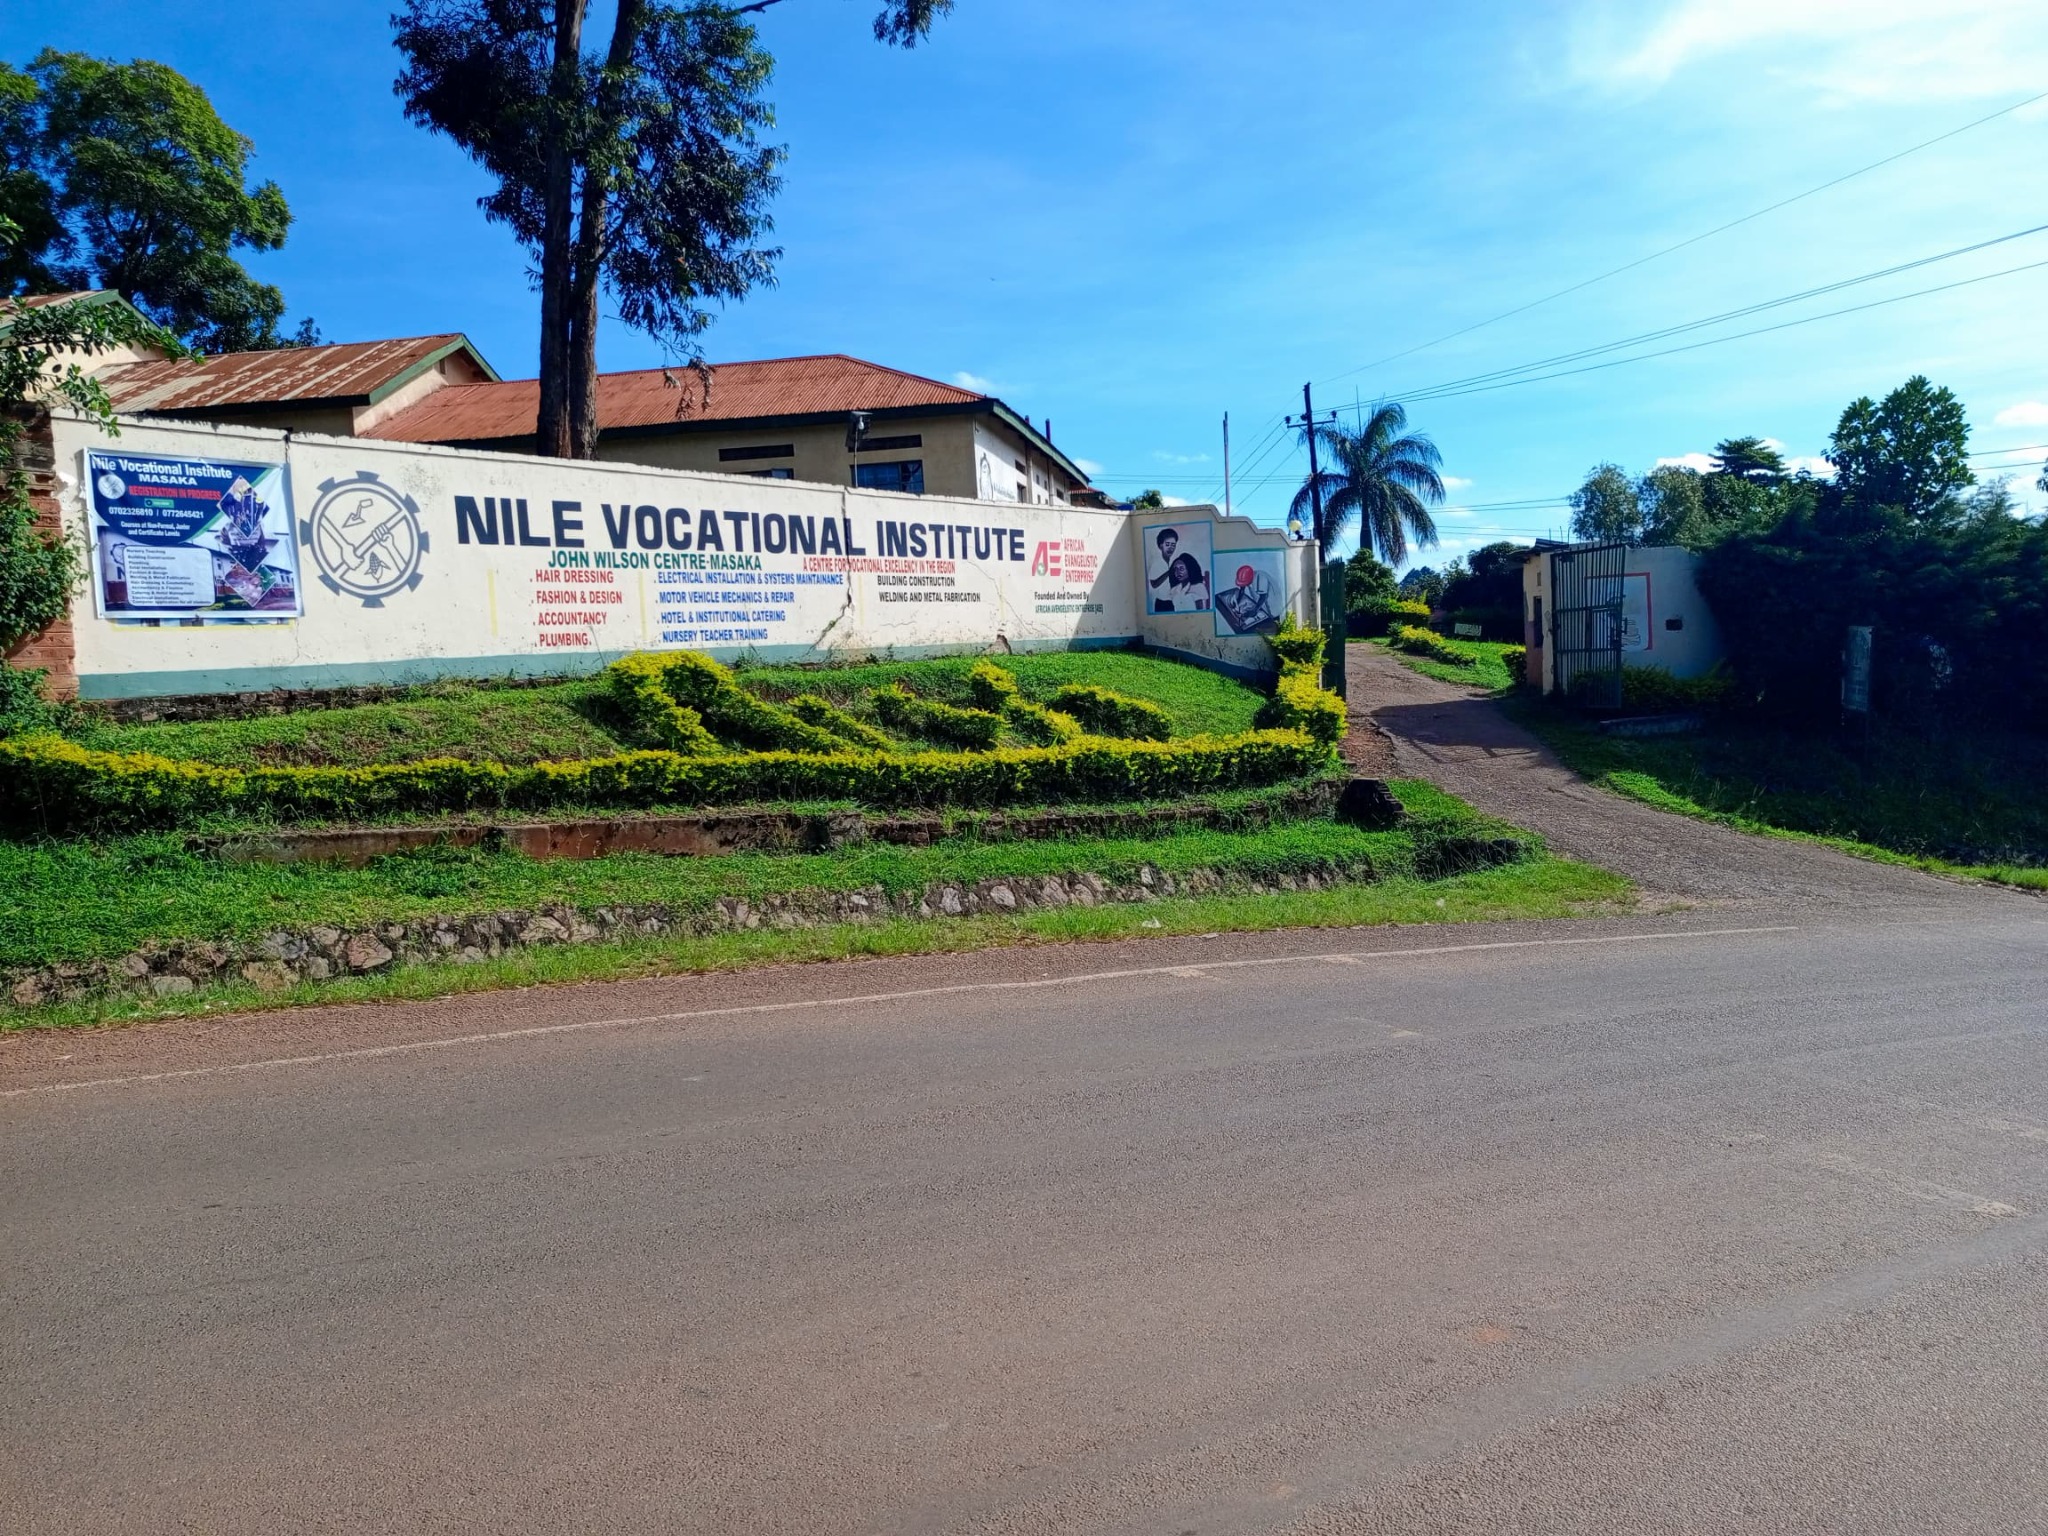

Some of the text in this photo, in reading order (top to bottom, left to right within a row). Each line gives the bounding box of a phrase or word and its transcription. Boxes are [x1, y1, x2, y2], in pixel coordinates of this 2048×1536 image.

[92, 456, 233, 479] Nile Vocational Institute
[138, 474, 198, 486] MASAKA
[129, 485, 221, 501] REGISTRATION IN PROGRESS
[454, 495, 1025, 562] NILE VOCATIONAL INSTITUTE
[1064, 538, 1085, 552] AFRICAN
[548, 550, 590, 569] JOHN
[594, 551, 649, 570] WILSON
[803, 558, 808, 572] A
[809, 558, 834, 573] CENTRE
[835, 558, 847, 573] FOR
[885, 559, 918, 573] EXCELLENCY
[919, 560, 926, 574] IN
[926, 560, 935, 574] THE
[936, 560, 956, 575] REGION
[1065, 554, 1098, 568] EVANGELISTIC
[536, 569, 614, 584] HAIR DRESSING
[658, 571, 844, 586] ELECTRICAL INSTALLATION & SYSTEMS MAINTAINANCE
[877, 575, 955, 587] BUILDING CONSTRUCTION
[1065, 570, 1094, 583] ENTERPRISE
[537, 590, 622, 604] FASHION & DESIGN
[659, 591, 795, 604] MOTOR VEHICLE MECHANICS & REPAIR
[879, 591, 981, 603] WELDING AND METAL FABRICATION
[1034, 591, 1089, 602] Founded And Owned By
[538, 612, 607, 625] ACCOUNTANCY
[661, 609, 786, 624] HOTEL & INSTITUTIONAL CATERING
[662, 628, 768, 643] NURSERY TEACHER TRAINING
